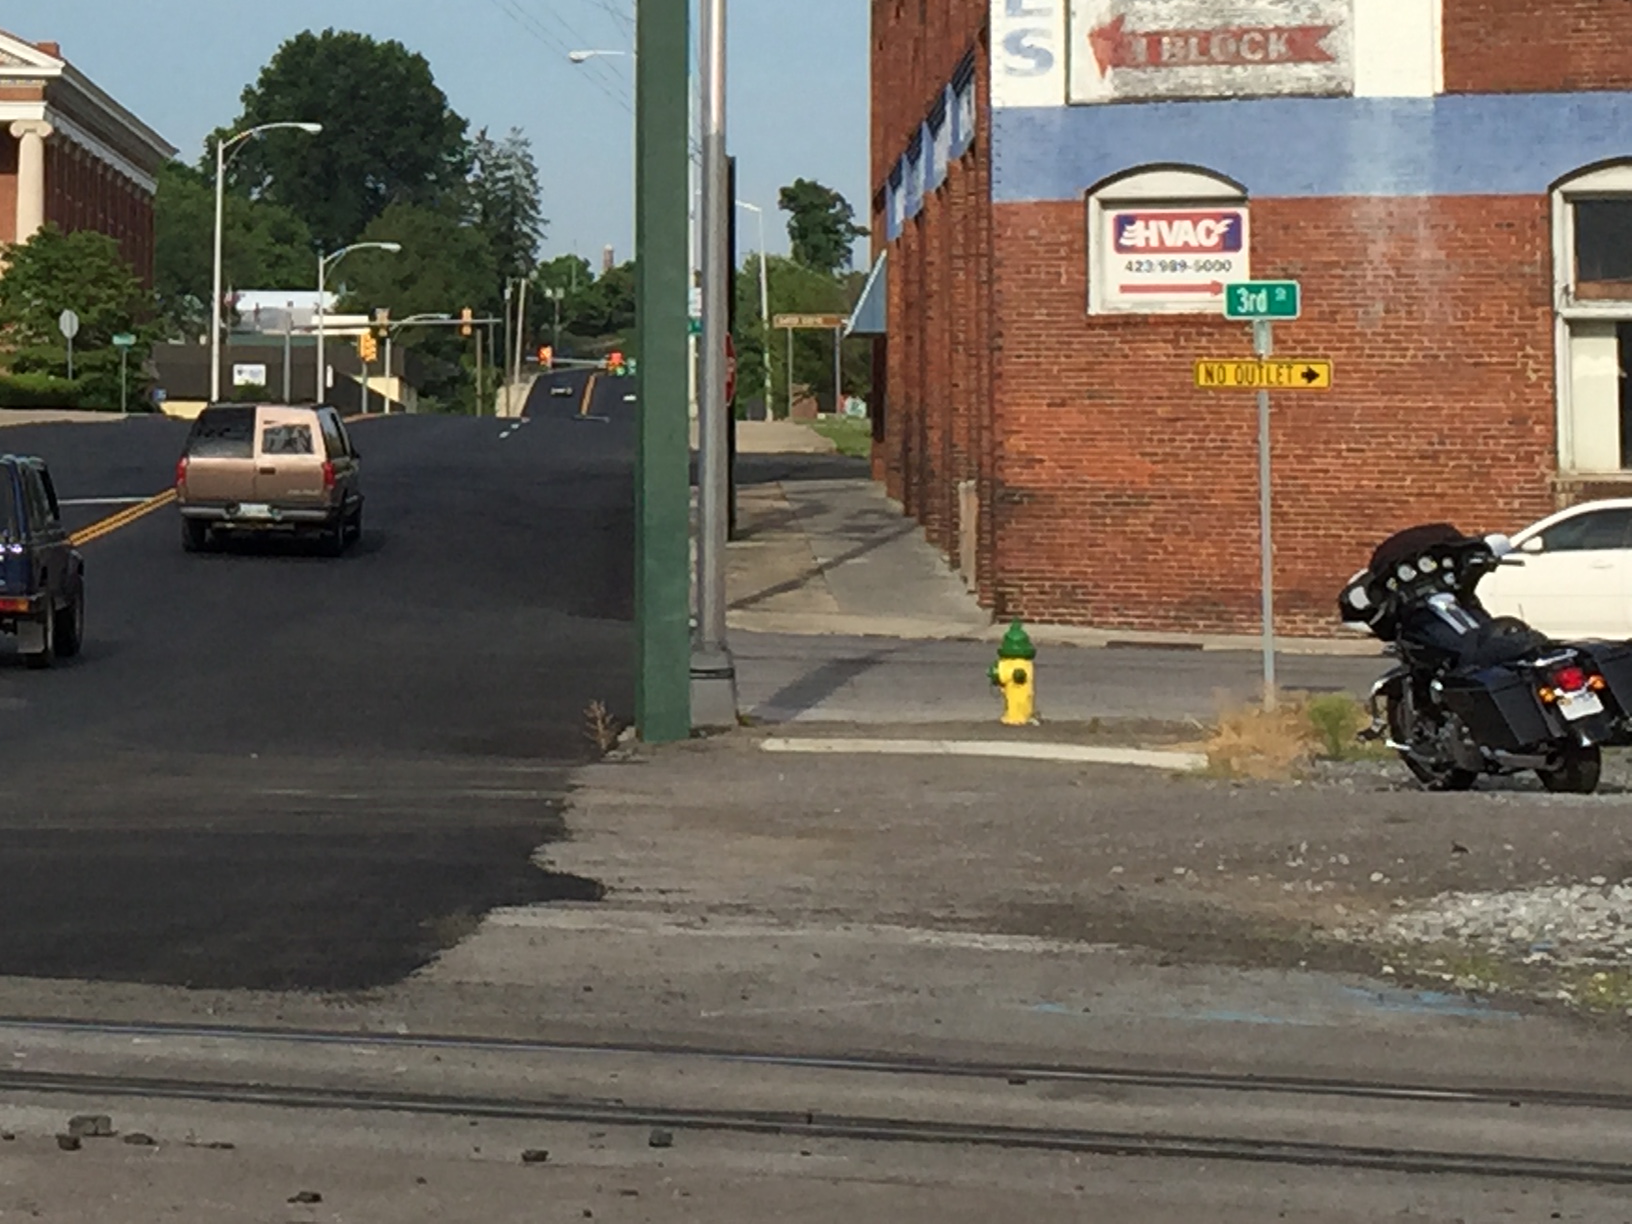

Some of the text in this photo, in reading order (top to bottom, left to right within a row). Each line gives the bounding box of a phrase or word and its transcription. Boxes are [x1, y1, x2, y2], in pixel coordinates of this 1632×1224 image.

[1161, 31, 1292, 62] BLOCK
[1129, 218, 1225, 248] HVAC
[1236, 287, 1267, 313] 3rd
[1204, 365, 1293, 384] NO OUTLET
